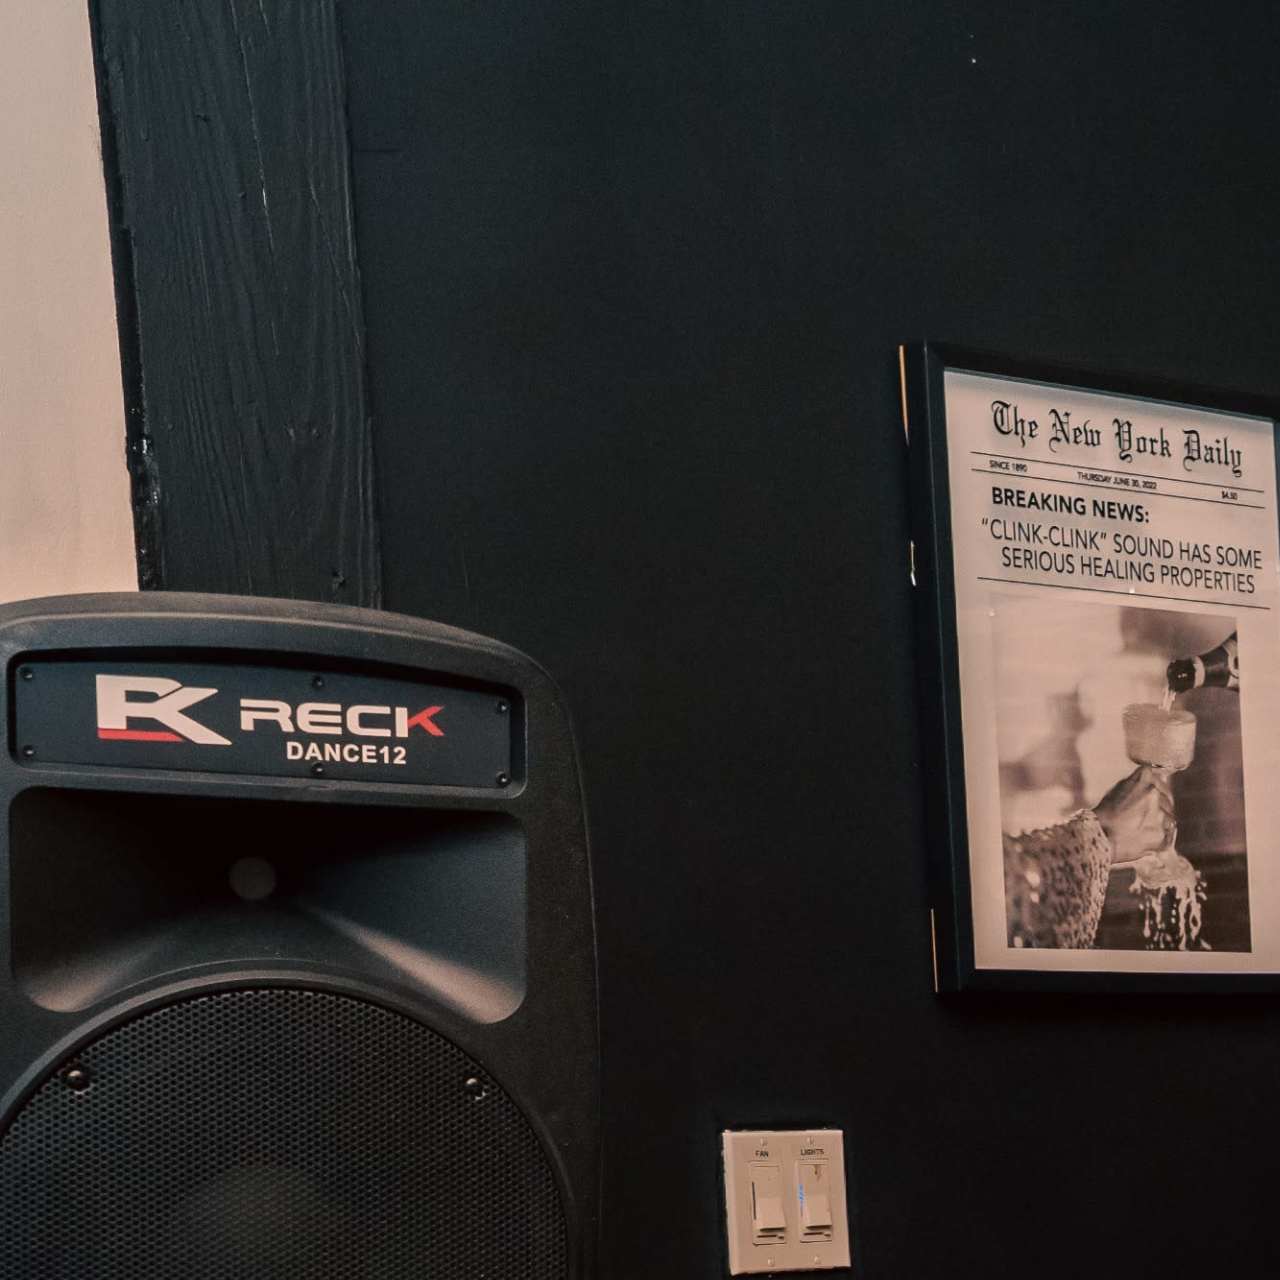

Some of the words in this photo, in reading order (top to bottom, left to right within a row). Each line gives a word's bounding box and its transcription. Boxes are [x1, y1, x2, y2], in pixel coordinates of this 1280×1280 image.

[990, 399, 1039, 449] The
[1048, 408, 1101, 453] New
[1112, 416, 1172, 463] York
[1183, 428, 1243, 478] Daily
[988, 459, 1010, 472] SINCE
[1077, 470, 1112, 485] THURSDAY
[1113, 475, 1130, 487] JUNE
[991, 487, 1086, 516] BREAKING
[1093, 501, 1150, 524] NEWS:
[1113, 533, 1174, 560] SOUND
[1179, 542, 1211, 564] HAS
[1215, 546, 1262, 570] SOME
[1001, 546, 1075, 575] SERIOUS
[1081, 556, 1155, 585] HEALING
[1160, 566, 1256, 595] PROPERTIES
[240, 698, 445, 739] RECK
[286, 741, 407, 765] DANCE12
[800, 1148, 824, 1156] LIGHTS
